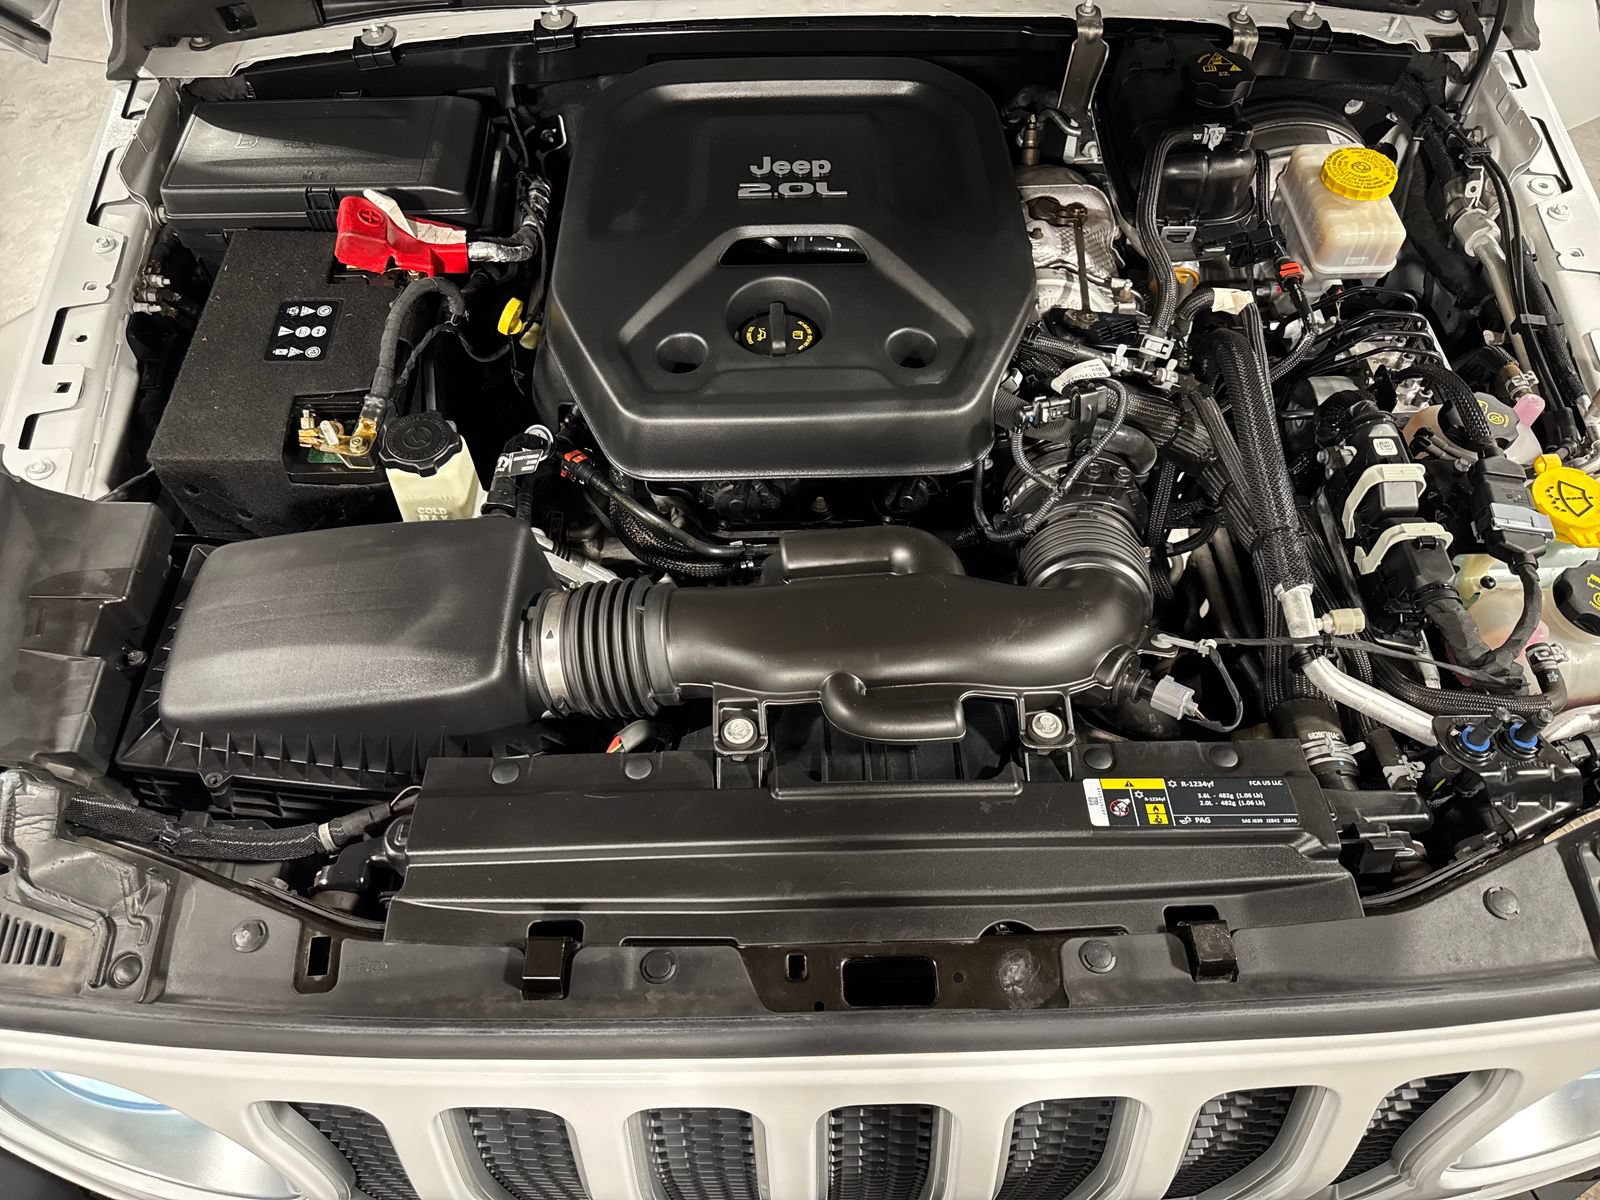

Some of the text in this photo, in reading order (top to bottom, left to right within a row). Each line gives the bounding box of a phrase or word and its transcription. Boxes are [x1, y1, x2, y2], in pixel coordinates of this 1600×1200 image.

[749, 156, 832, 178] Jeep
[738, 182, 848, 199] 2.0L
[417, 507, 447, 515] COLD
[1180, 780, 1215, 789] R-1234yf
[1218, 792, 1235, 800] 482g
[1195, 816, 1211, 824] PAG
